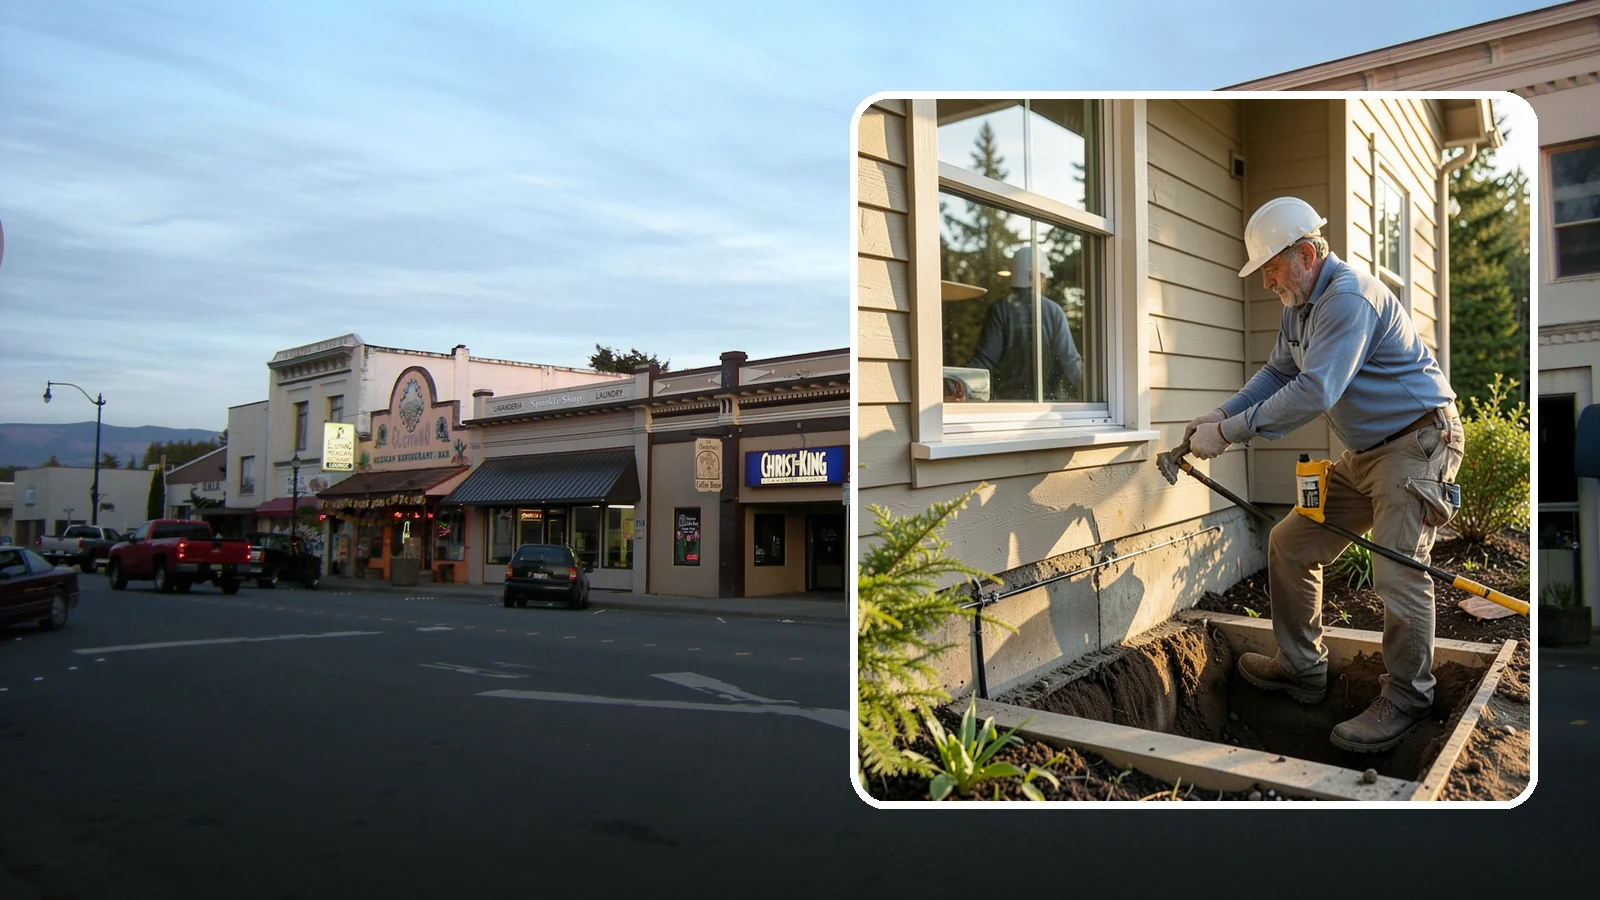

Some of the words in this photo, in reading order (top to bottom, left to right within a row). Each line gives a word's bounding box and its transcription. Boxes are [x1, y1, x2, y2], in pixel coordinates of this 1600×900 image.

[530, 396, 561, 409] Sparkle
[561, 394, 583, 405] Shop
[596, 390, 623, 400] LAUNDRY
[493, 402, 523, 413] LAVANDERIA
[374, 455, 395, 464] MEXICAN
[398, 452, 433, 462] RESTAURANT
[438, 450, 450, 459] BAR
[761, 452, 797, 478] CHRIST
[799, 450, 827, 476] KING
